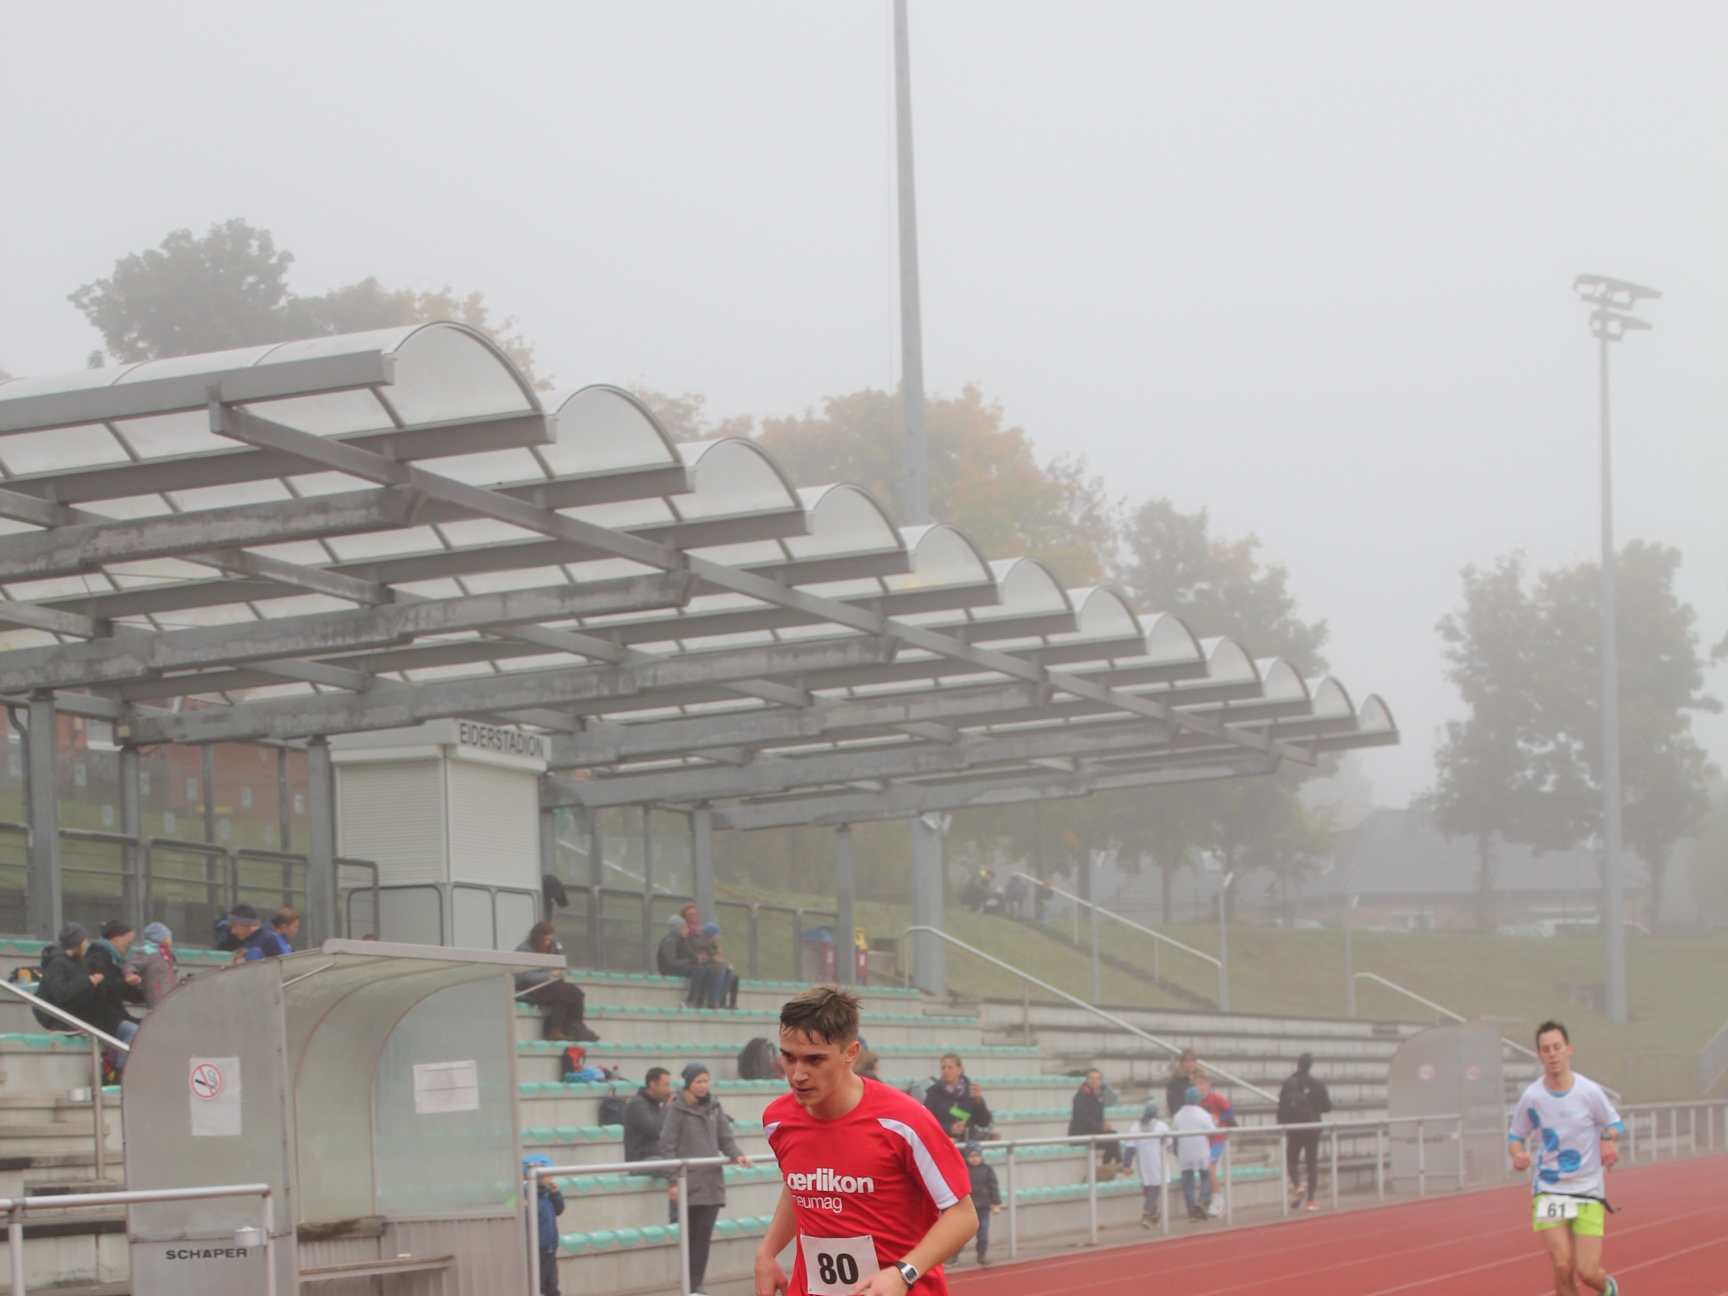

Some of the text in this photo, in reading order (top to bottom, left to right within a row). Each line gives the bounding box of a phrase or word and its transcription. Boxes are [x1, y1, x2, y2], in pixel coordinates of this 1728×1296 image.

[460, 722, 546, 758] EIDERSTADION
[792, 1195, 843, 1214] eumag
[1547, 1203, 1567, 1218] 61
[165, 1247, 248, 1260] SCHAPER
[816, 1252, 860, 1285] 80
